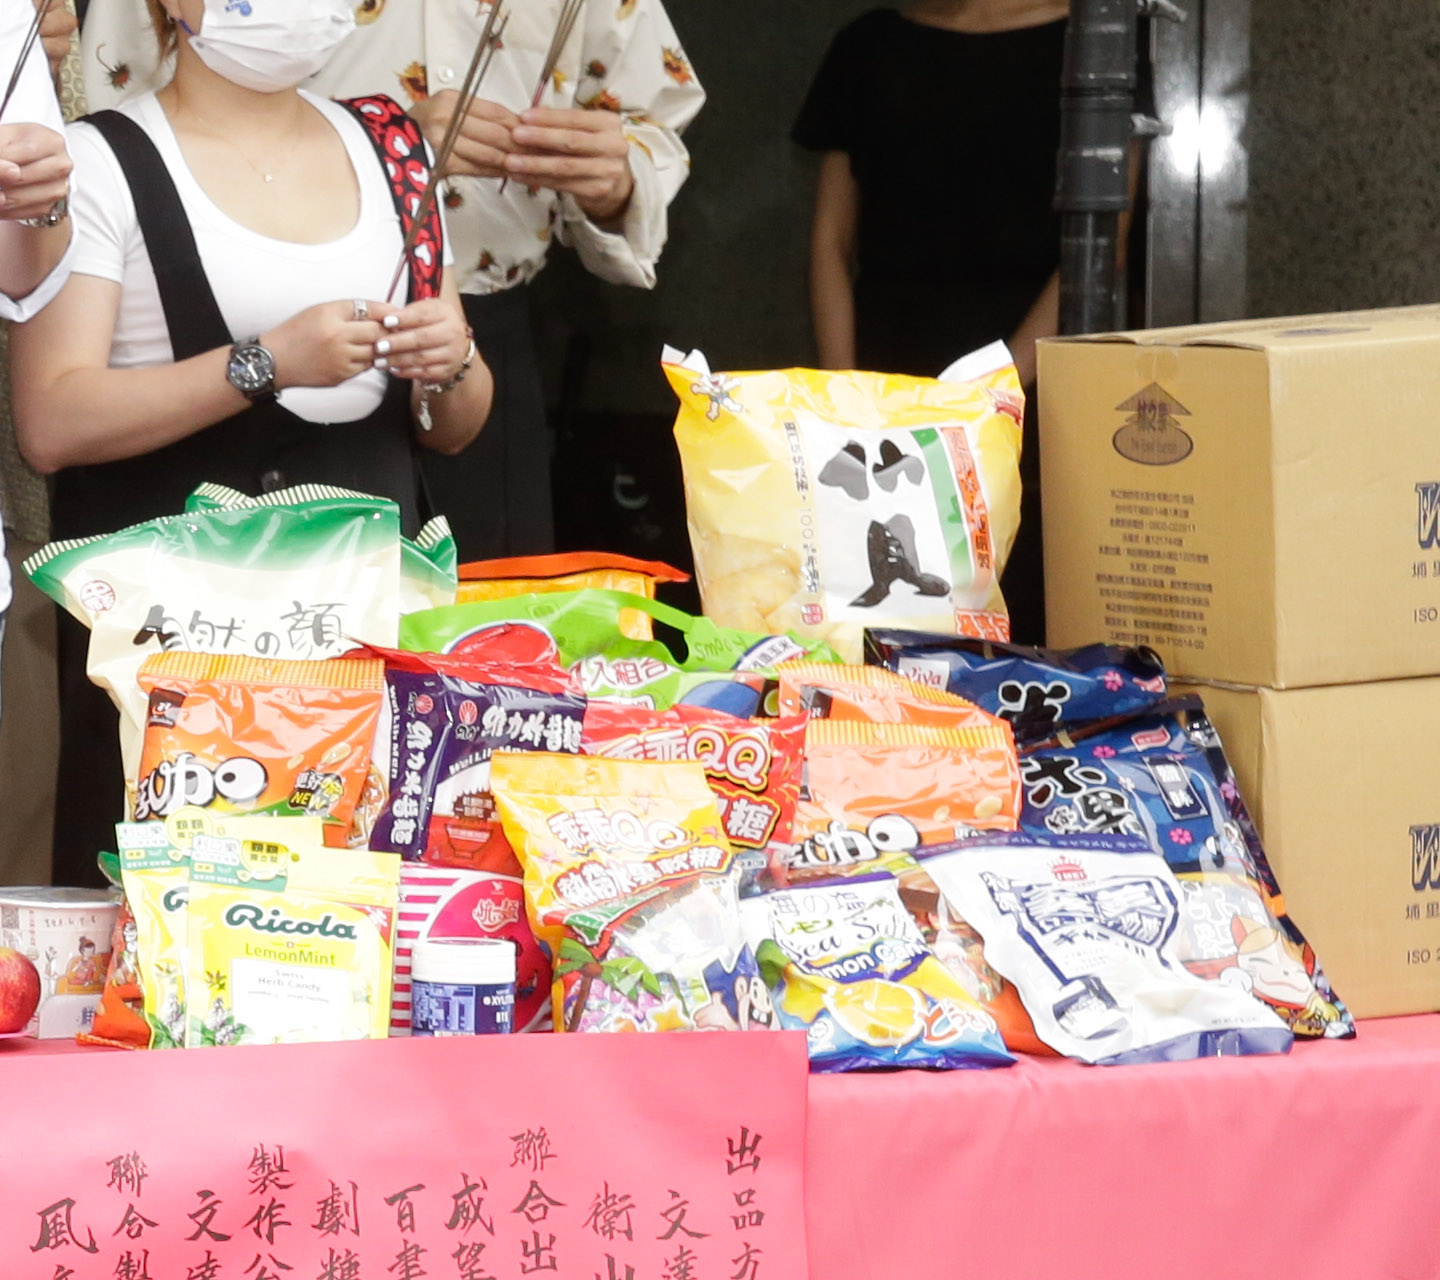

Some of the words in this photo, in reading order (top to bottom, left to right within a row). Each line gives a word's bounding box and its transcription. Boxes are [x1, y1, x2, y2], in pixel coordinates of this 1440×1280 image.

[1413, 609, 1438, 624] ISO
[291, 791, 326, 811] NEW
[546, 809, 689, 851] 乖乖QQ
[225, 903, 358, 941] Ricola
[244, 941, 337, 967] LemonMint
